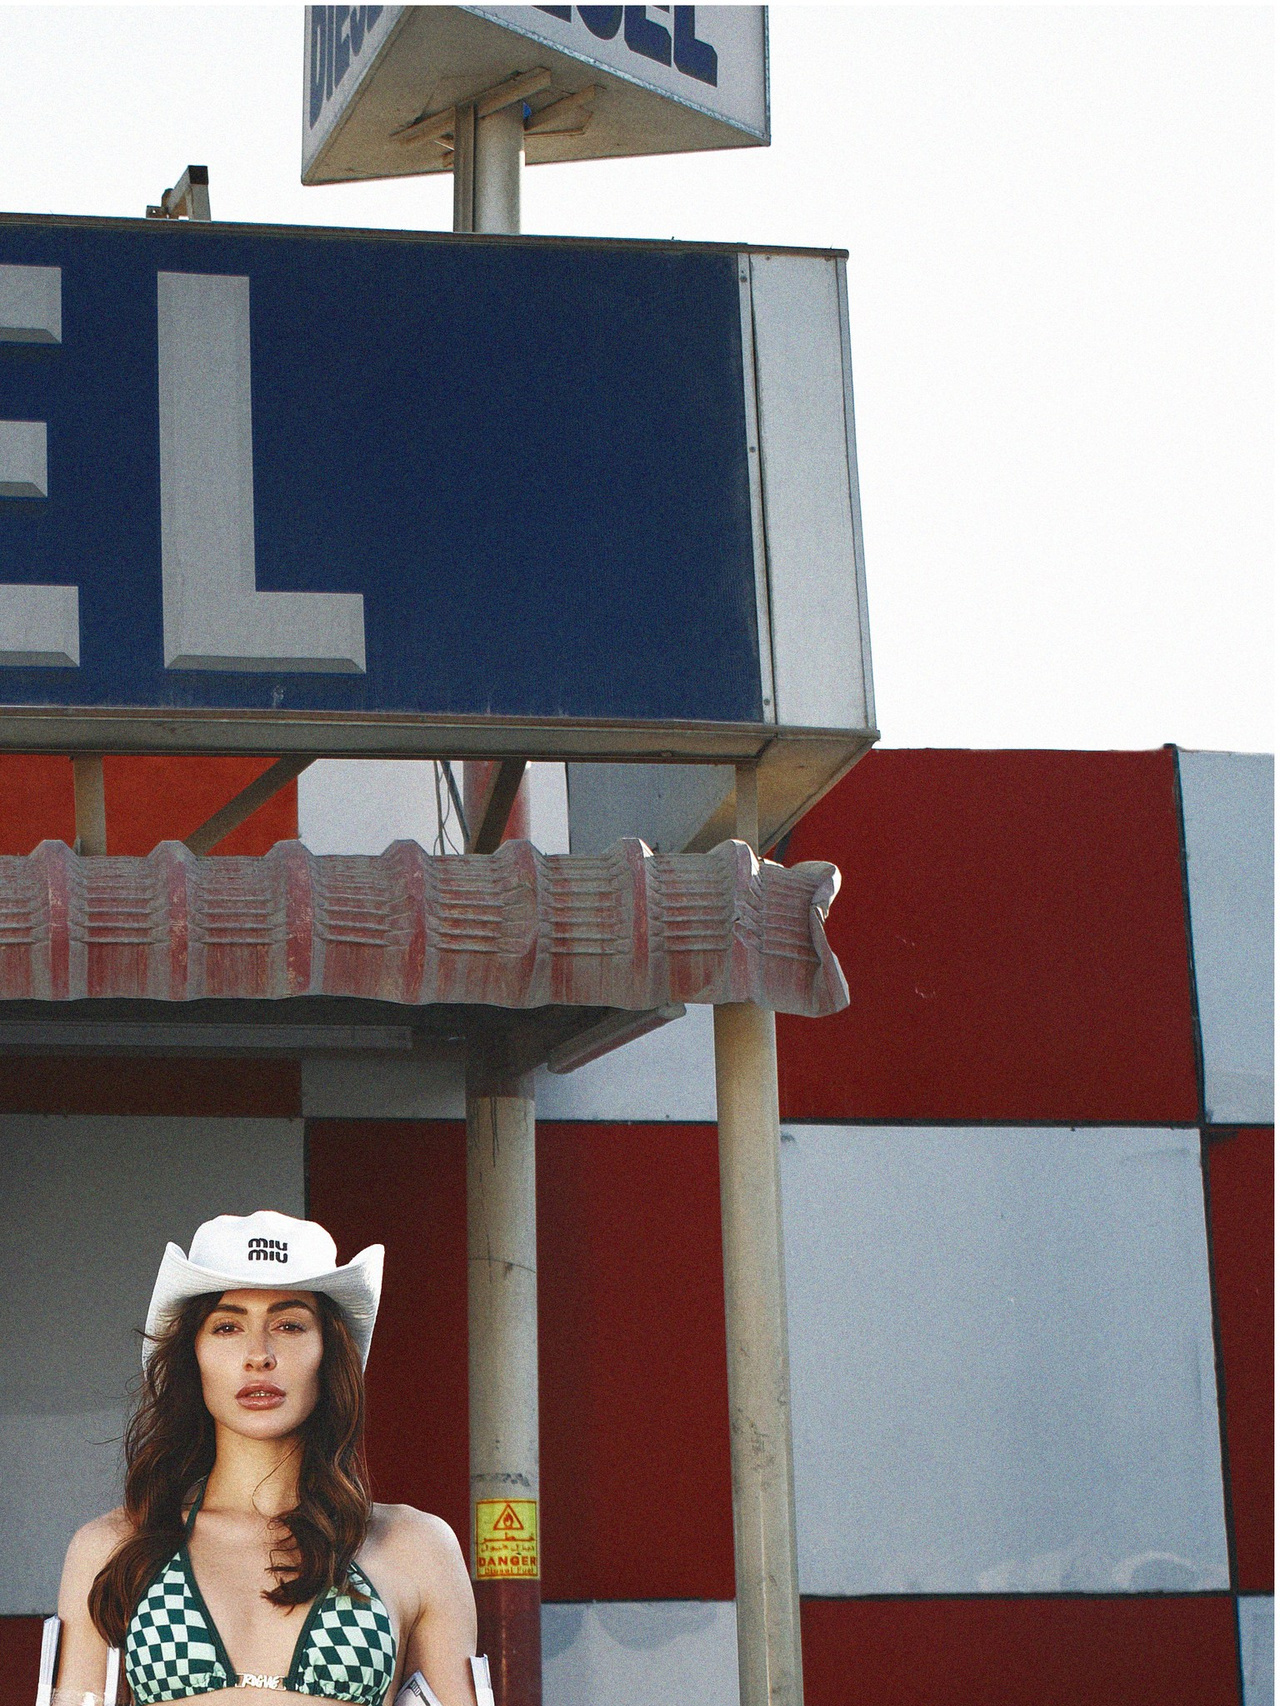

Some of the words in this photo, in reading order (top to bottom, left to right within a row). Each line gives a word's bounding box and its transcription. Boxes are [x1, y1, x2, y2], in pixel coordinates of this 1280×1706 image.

[248, 1238, 288, 1251] miu
[248, 1249, 288, 1263] miu
[478, 1555, 536, 1567] DANGER
